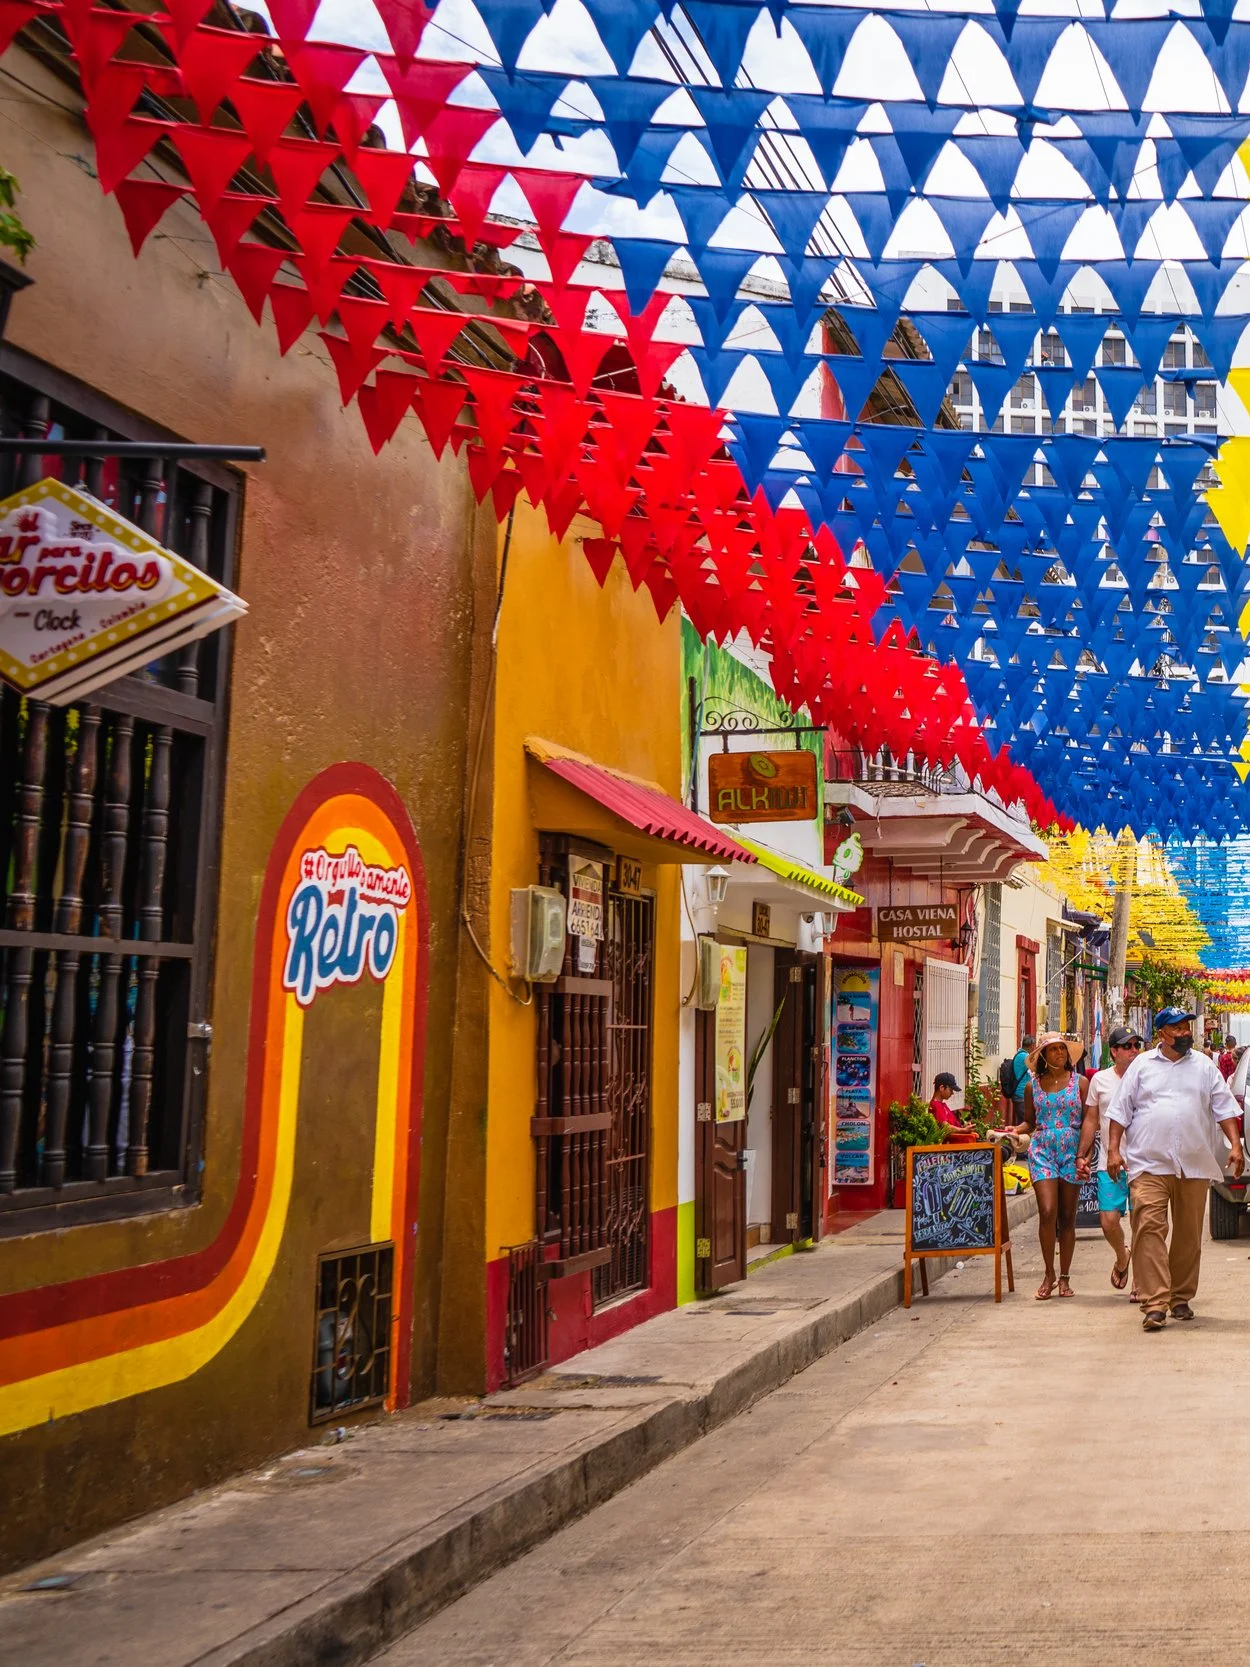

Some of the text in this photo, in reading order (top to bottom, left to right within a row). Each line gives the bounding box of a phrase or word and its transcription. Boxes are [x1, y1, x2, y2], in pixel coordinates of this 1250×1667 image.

[0, 552, 161, 597] orcitos
[30, 633, 86, 664] Cartagena
[99, 602, 147, 629] Colombia
[304, 853, 409, 899] #Orgullosamente
[879, 908, 956, 921] CASA VIENA
[893, 925, 943, 938] HOSTAL
[288, 885, 395, 997] Retro
